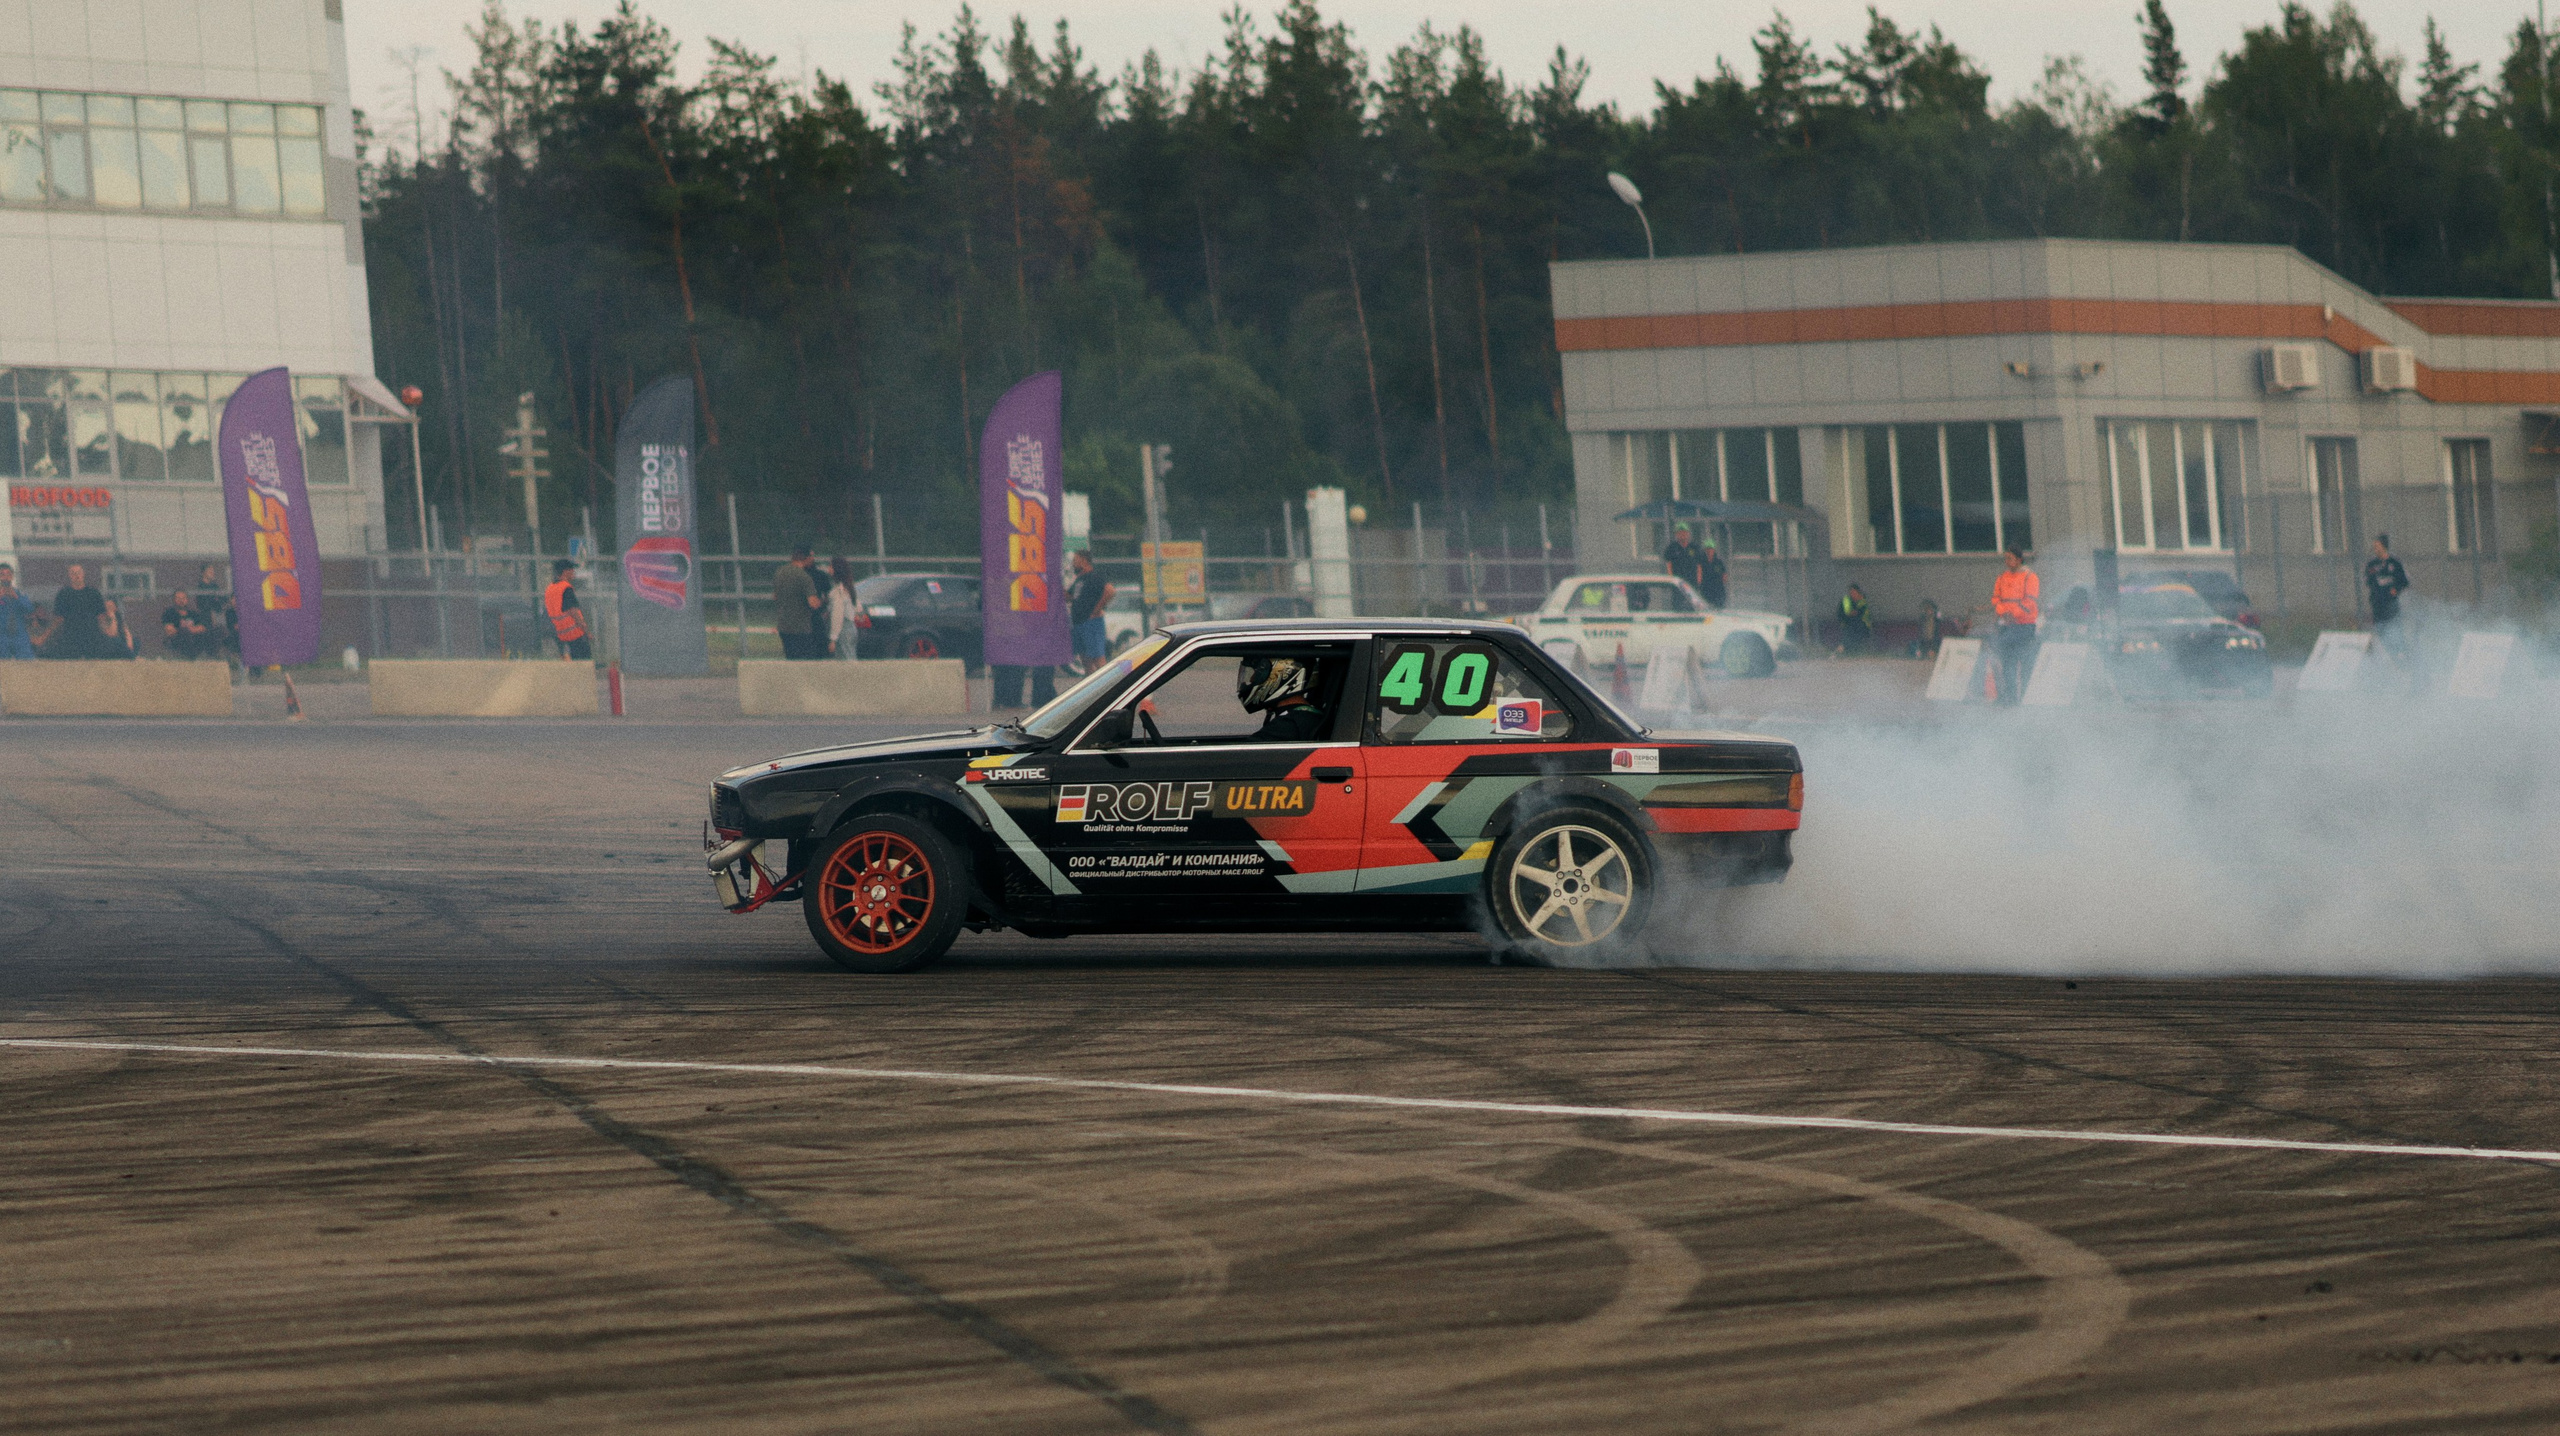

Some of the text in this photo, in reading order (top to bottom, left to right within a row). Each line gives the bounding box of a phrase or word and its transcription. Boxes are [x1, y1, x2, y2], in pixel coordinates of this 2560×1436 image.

[642, 444, 662, 531] ПЕРВОЕ
[661, 445, 681, 531] СЕТЕВОЕ
[248, 487, 302, 611] DBS
[1007, 489, 1048, 612] DBS
[1379, 651, 1490, 707] 40
[1083, 823, 1189, 834] Qualität ohne Kompromisse
[1084, 781, 1305, 822] ROLF ULTRA
[1069, 856, 1096, 867] ООО
[1172, 855, 1183, 866] И
[1184, 853, 1265, 866] КОМПАНИЯ»
[1069, 869, 1125, 878] ОФИЦИАЛЬНЫЙ
